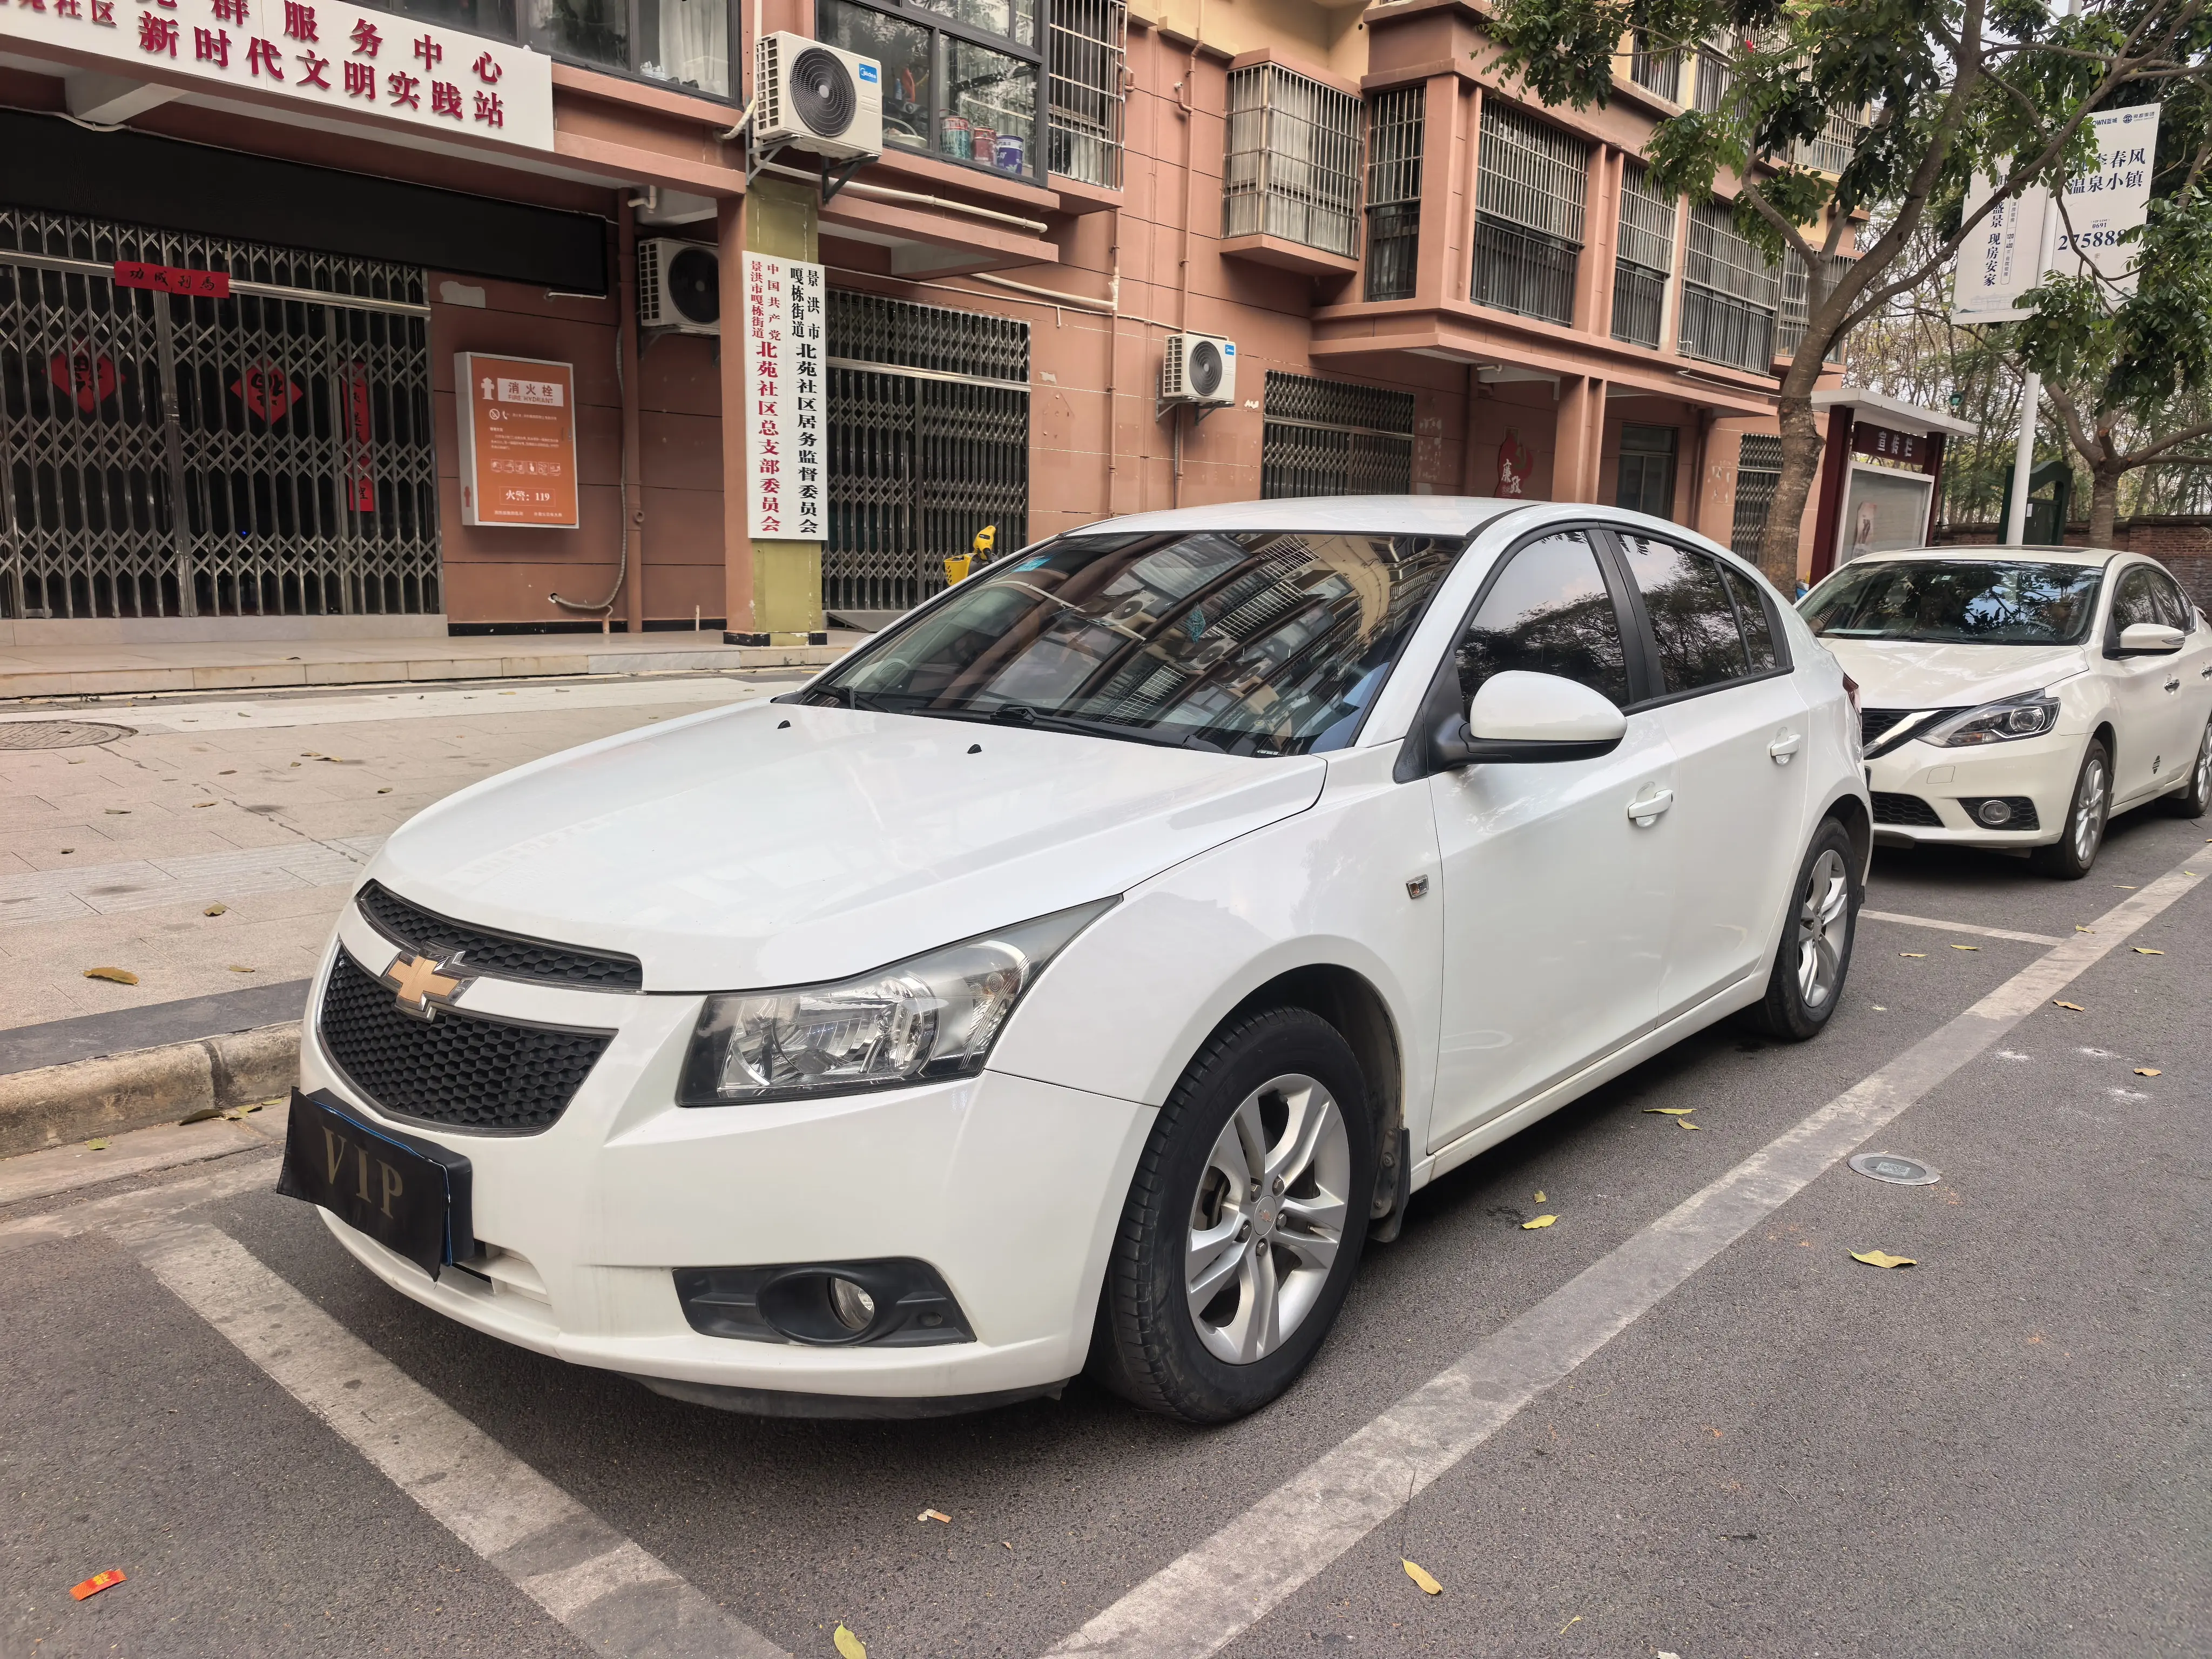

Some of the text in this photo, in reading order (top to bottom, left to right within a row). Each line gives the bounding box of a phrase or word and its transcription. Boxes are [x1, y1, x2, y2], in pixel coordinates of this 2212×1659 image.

[0, 0, 117, 26] 社区
[157, 0, 503, 83] 群服务中心
[138, 10, 504, 127] 新时代文明实践站
[860, 68, 876, 79] Midea
[2071, 170, 2144, 194] 温泉小镇
[1983, 232, 2001, 286] 现房安家
[750, 260, 765, 339] 景洪市嘎栋街道
[767, 263, 781, 341] 中国共产党
[790, 267, 805, 339] 嘎栋街道
[806, 269, 821, 340] 景洪市
[508, 381, 554, 397] 消火栓
[524, 396, 554, 404] HYDRANT
[756, 340, 782, 532] 北苑社区总支部委员会
[795, 343, 820, 534] 北苑社区居务监督委员会
[535, 492, 550, 501] 119
[322, 1125, 404, 1219] VIP
